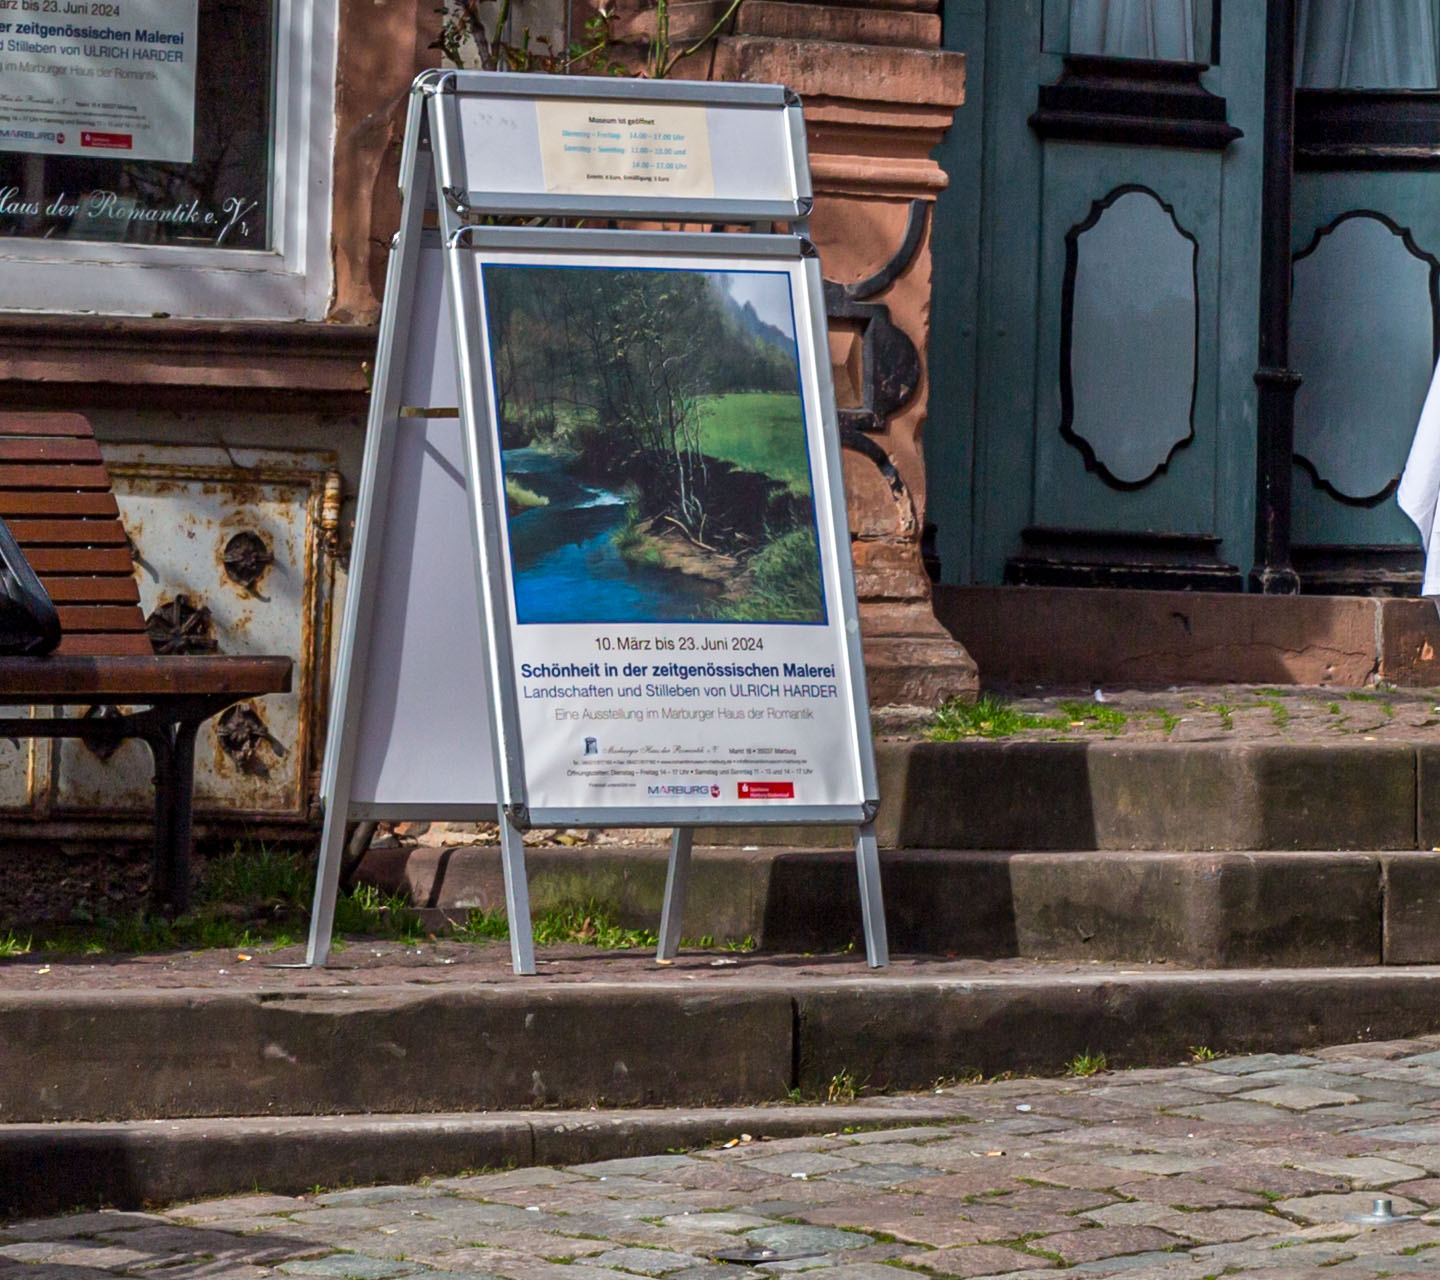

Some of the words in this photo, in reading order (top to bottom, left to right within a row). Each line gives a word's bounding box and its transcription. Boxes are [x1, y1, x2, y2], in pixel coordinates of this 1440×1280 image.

[42, 0, 62, 13] 23.
[63, 1, 87, 15] Juni
[90, 3, 121, 18] 2024
[15, 18, 131, 41] zeitgenössischen
[135, 26, 184, 46] Malerei
[7, 38, 57, 55] Stilleben
[60, 45, 81, 56] von
[83, 44, 129, 59] ULRICH
[132, 47, 184, 63] HARDER
[19, 62, 67, 77] Marburger
[114, 67, 158, 81] Romantik
[588, 116, 617, 125] Museum
[618, 117, 626, 125] ist
[627, 117, 655, 127] geöffnet
[672, 133, 685, 141] Uhr
[674, 148, 687, 156] und
[675, 163, 687, 171] Uhr
[45, 191, 80, 217] der
[87, 188, 200, 223] Romantik
[595, 637, 615, 651] 10.
[617, 636, 652, 651] März
[655, 636, 676, 651] bis
[678, 637, 700, 651] 23.
[701, 636, 729, 651] Juni
[732, 637, 764, 651] 2024
[521, 663, 600, 678] Schönheit
[604, 662, 618, 677] in
[623, 662, 648, 677] der
[652, 662, 780, 680] zeitgenössischen
[783, 663, 836, 678] Malerei
[523, 685, 614, 699] Landschaften
[617, 684, 642, 697] und
[646, 684, 700, 698] Stilleben
[703, 687, 726, 697] von
[729, 683, 780, 698] ULRICH
[783, 684, 838, 698] HARDER
[555, 707, 579, 721] Eine
[582, 707, 644, 722] Ausstellung
[647, 707, 659, 720] im
[661, 707, 714, 722] Marburger
[718, 707, 745, 719] Haus
[747, 707, 765, 720] der
[767, 707, 814, 720] Romantik
[647, 785, 710, 795] MARBURG
